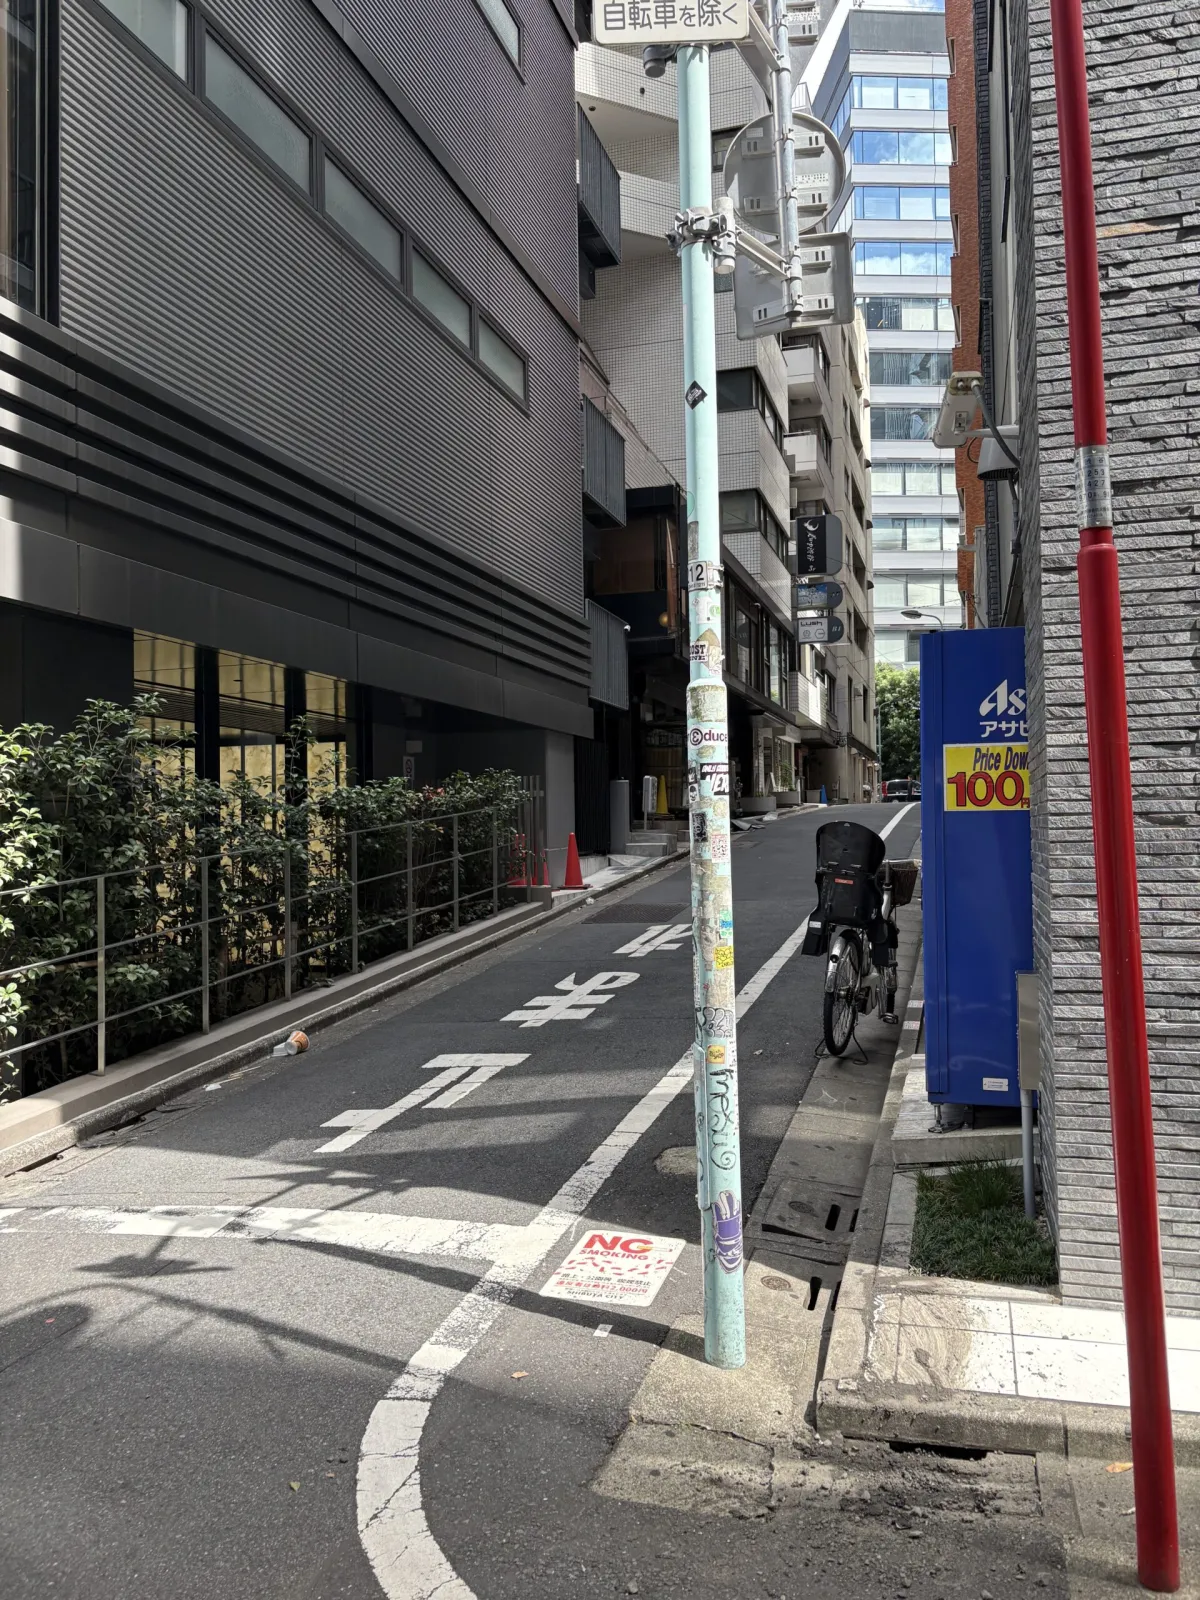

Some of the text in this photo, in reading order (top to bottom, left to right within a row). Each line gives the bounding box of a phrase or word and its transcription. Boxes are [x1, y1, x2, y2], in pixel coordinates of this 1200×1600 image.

[603, 0, 737, 30] 自転車を除く
[1087, 469, 1105, 477] 253
[1087, 480, 1106, 488] 427
[973, 746, 1029, 771] Price Dow
[578, 1249, 648, 1260] SMOKING
[566, 1290, 603, 1298] SHIBUYA
